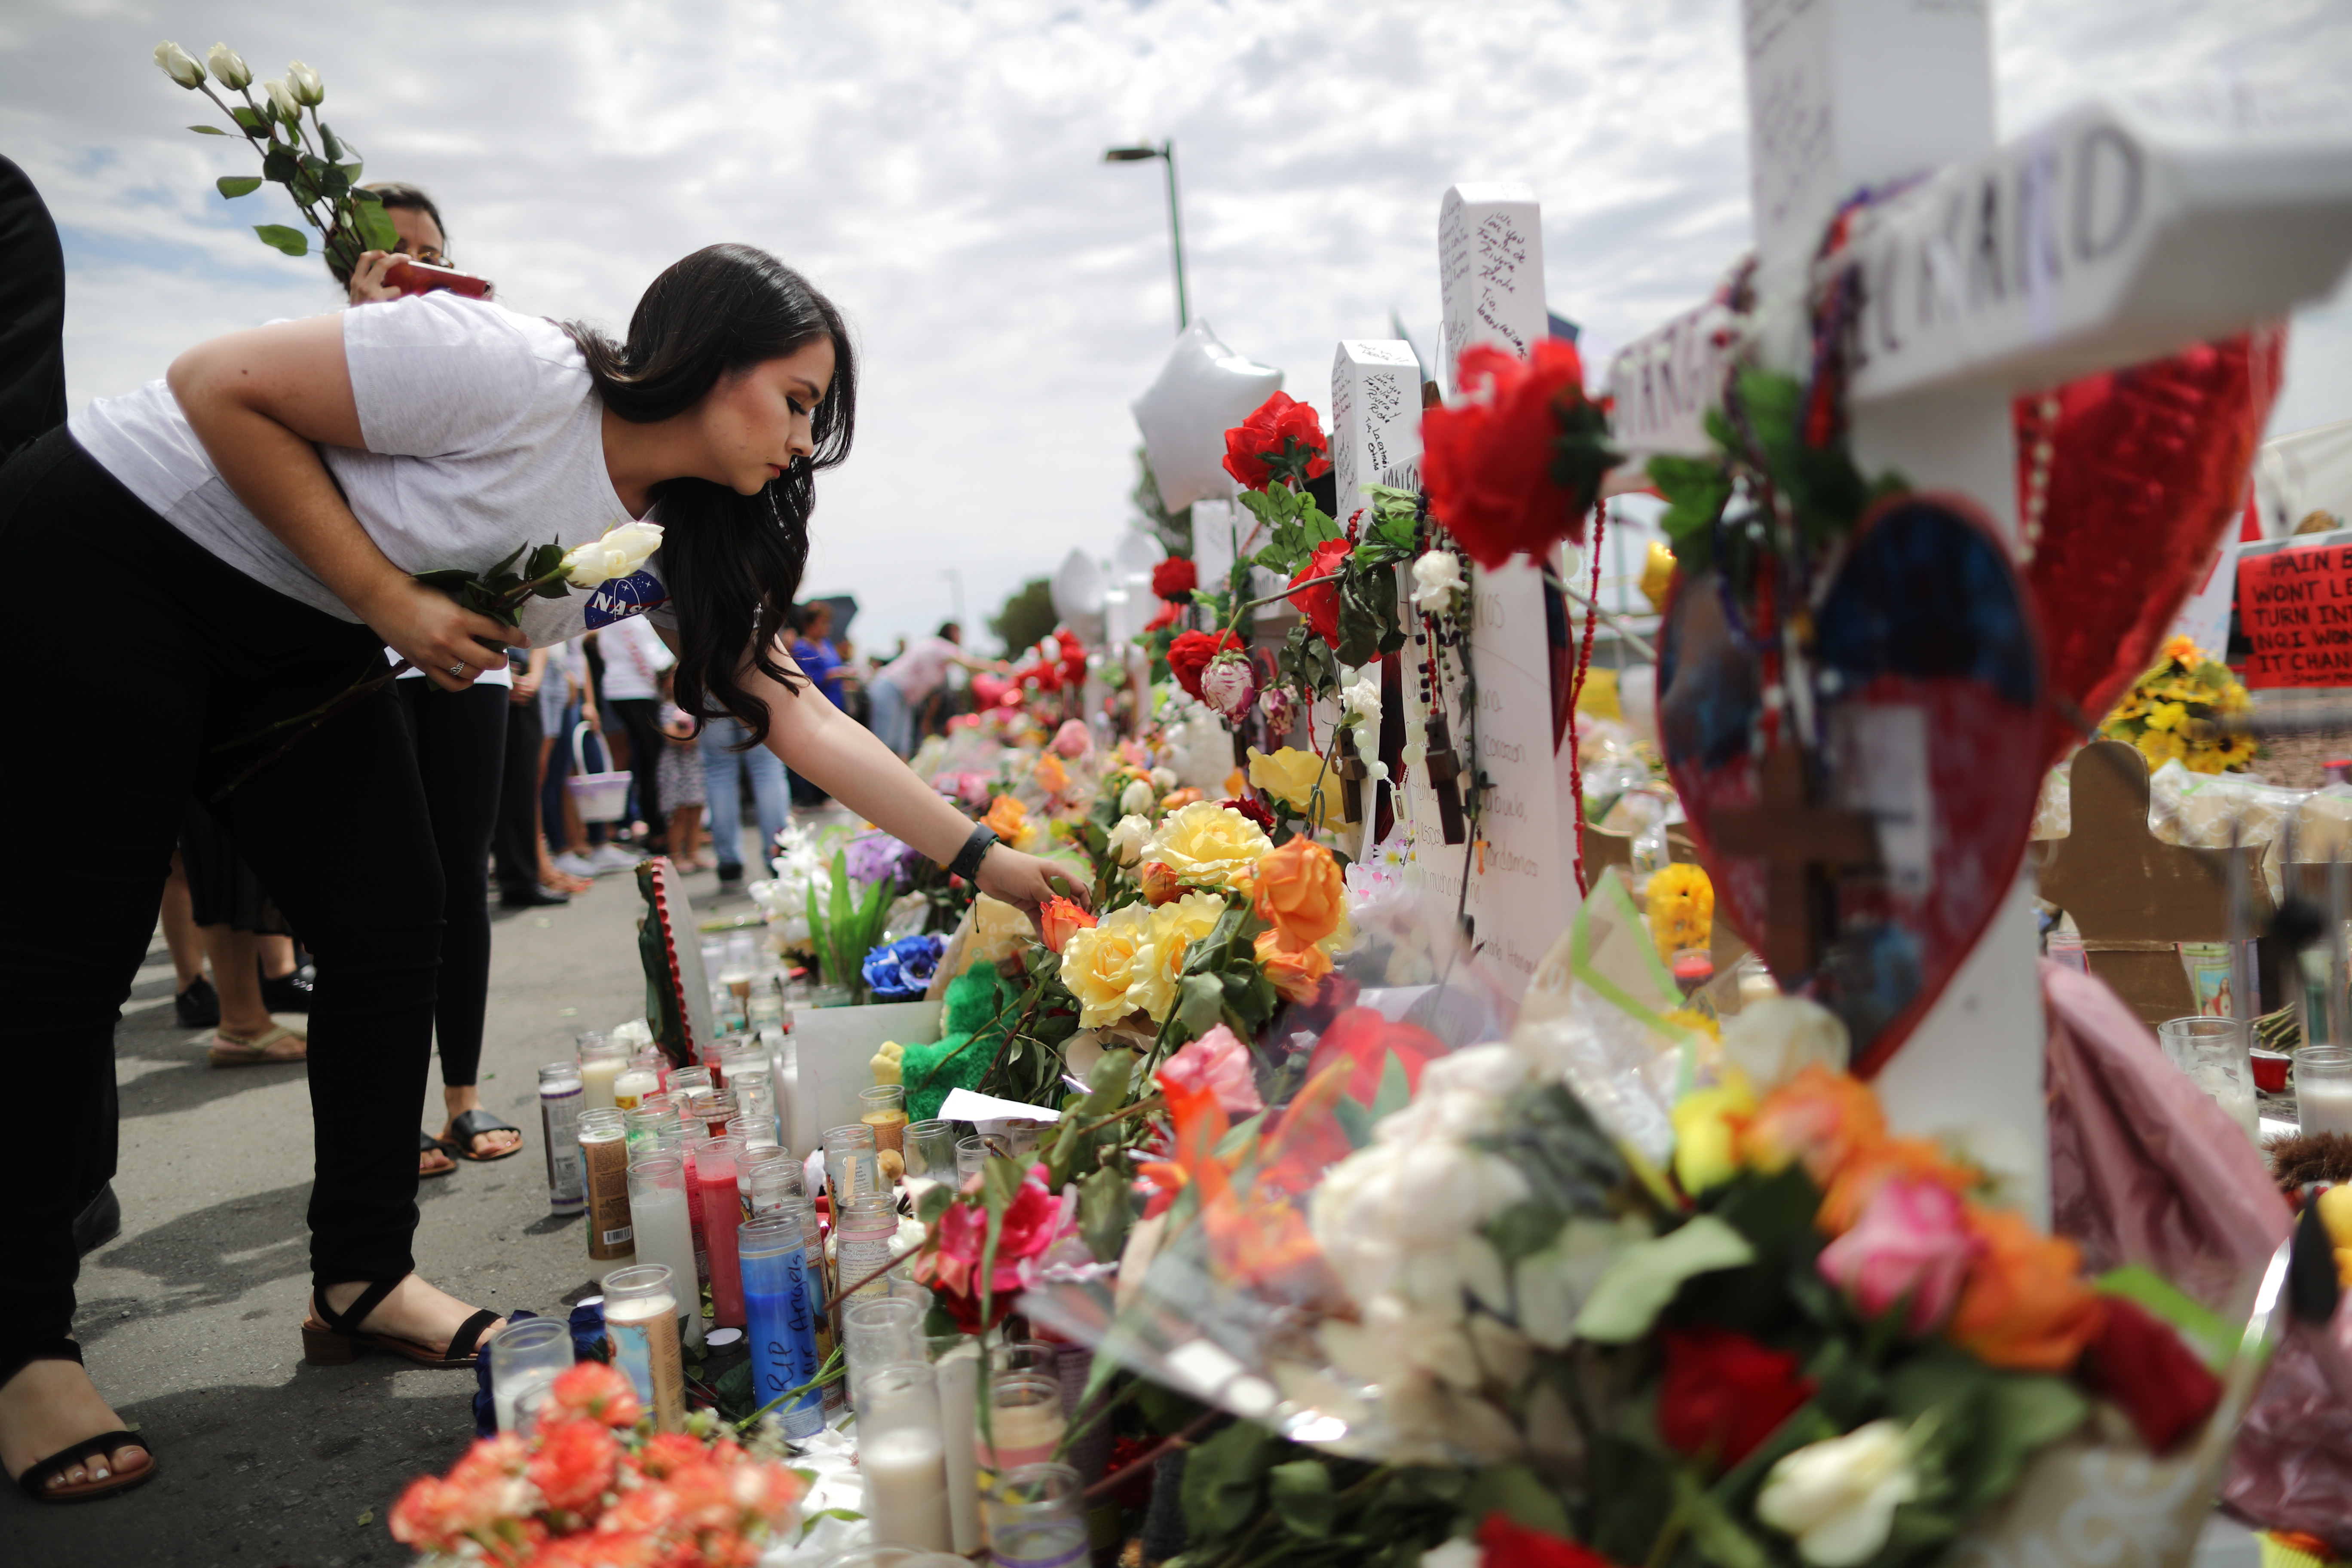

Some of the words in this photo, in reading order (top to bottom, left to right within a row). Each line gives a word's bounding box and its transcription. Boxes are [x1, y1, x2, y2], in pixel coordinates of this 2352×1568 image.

[2253, 606, 2311, 627] TURN
[787, 1254, 809, 1332] Angels
[766, 1341, 796, 1392] RIP
